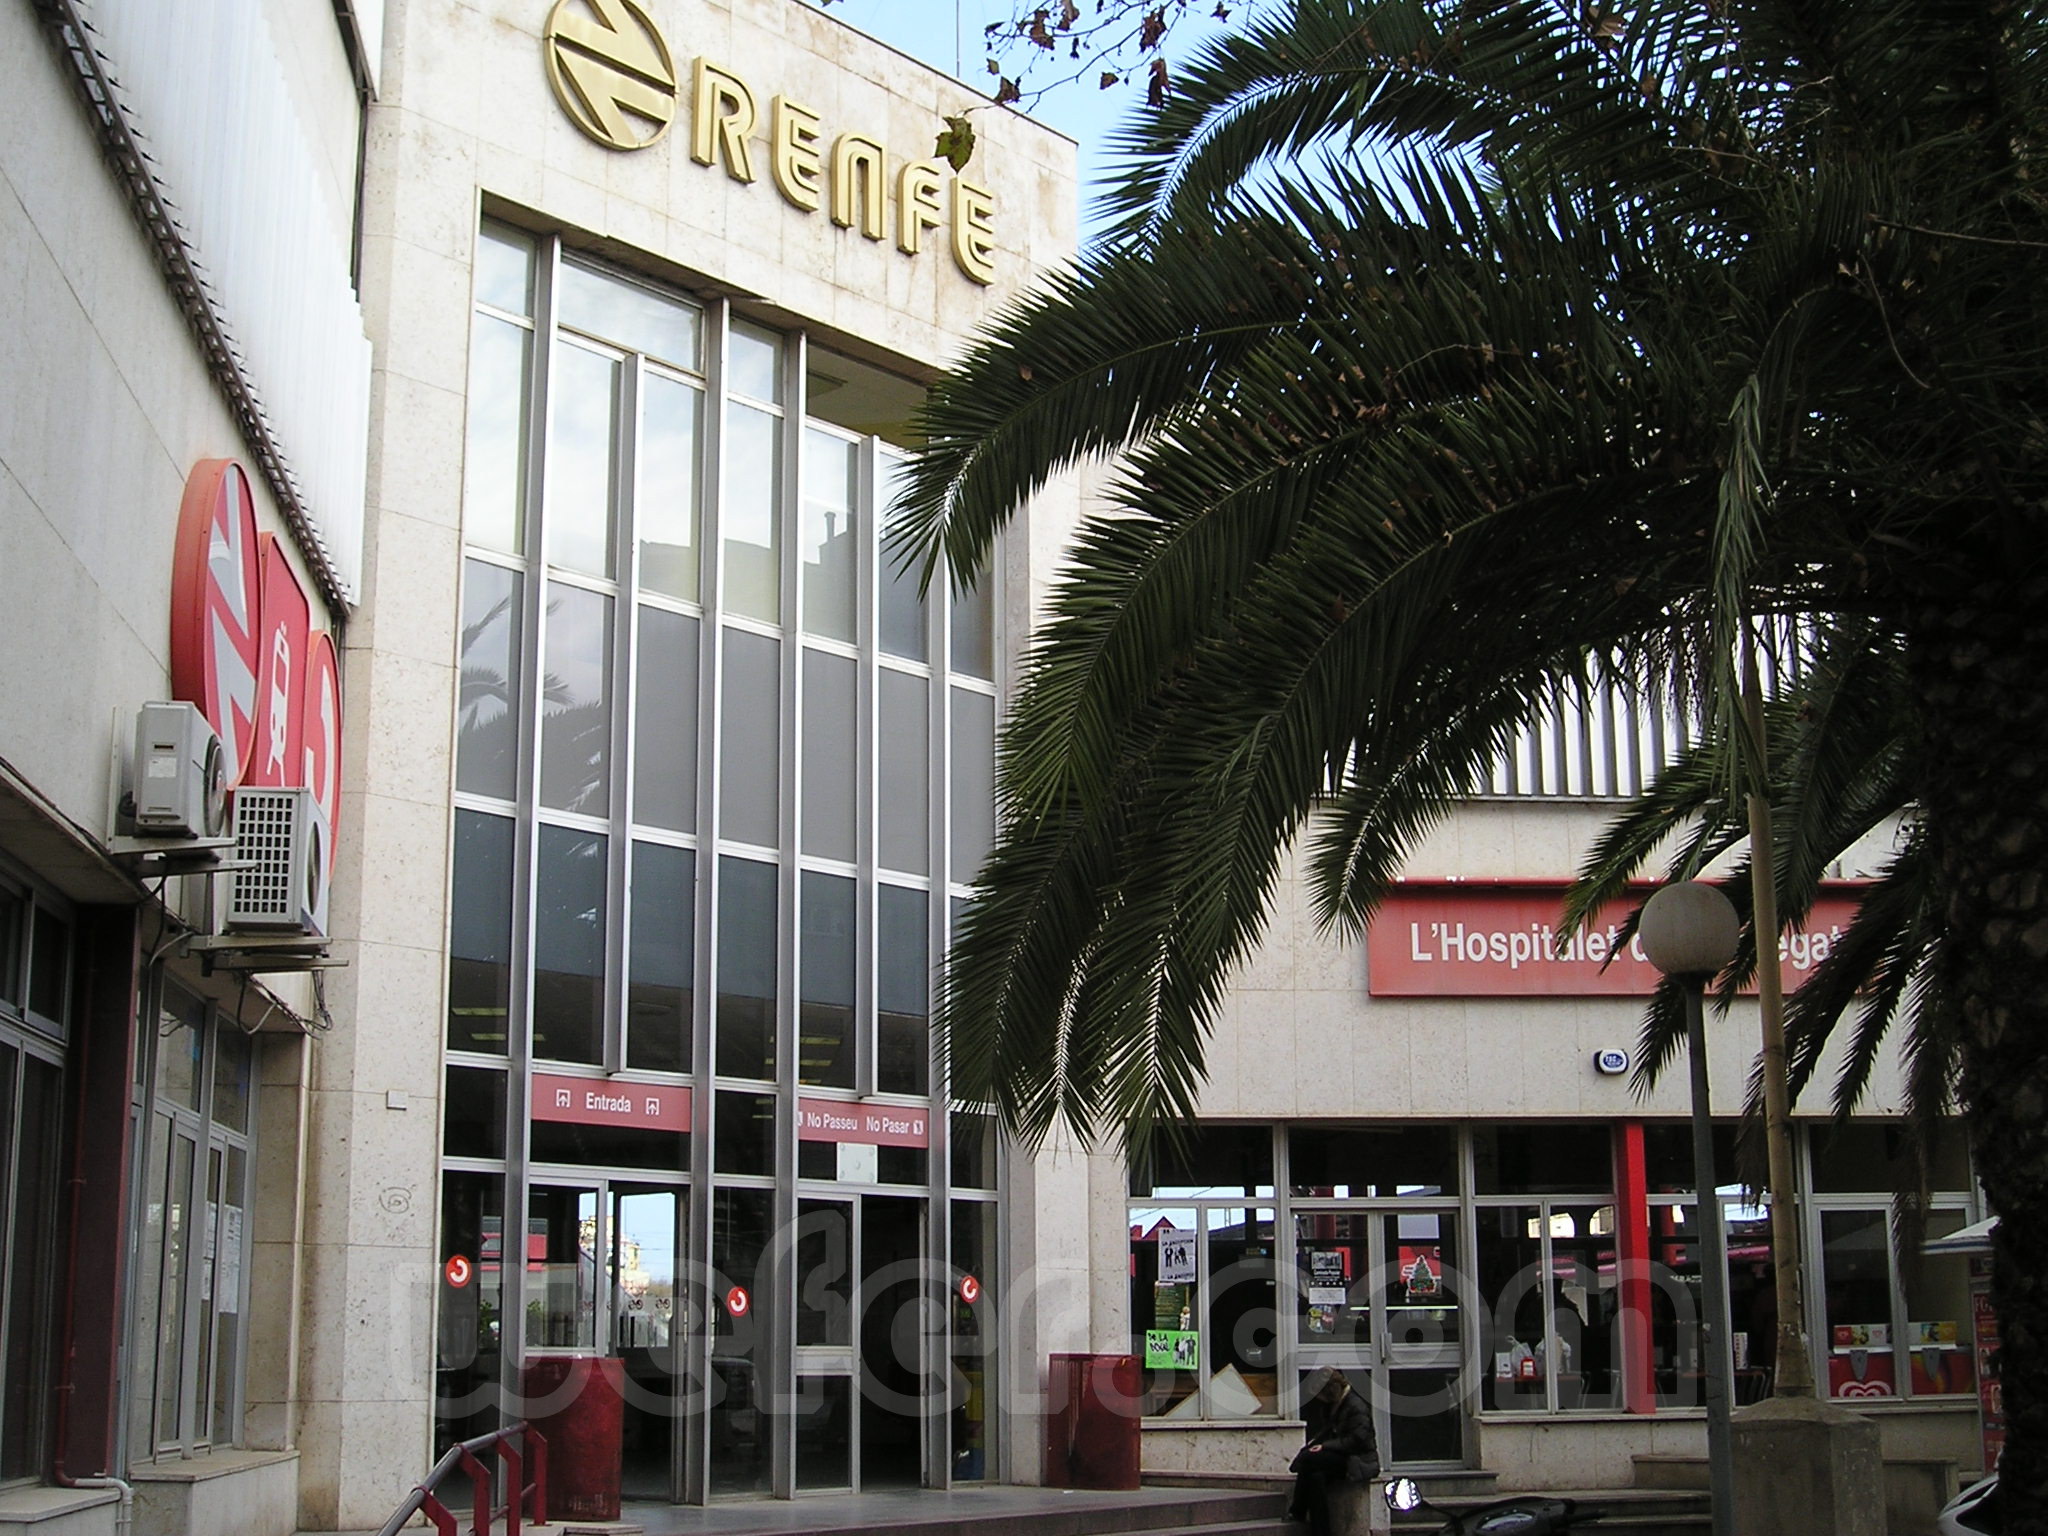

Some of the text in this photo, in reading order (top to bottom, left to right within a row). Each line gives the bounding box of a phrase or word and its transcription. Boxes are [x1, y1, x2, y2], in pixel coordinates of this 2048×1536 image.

[586, 1092, 632, 1113] Entrada
[807, 1112, 858, 1131] No Passeu
[866, 1116, 910, 1134] No Pasar
